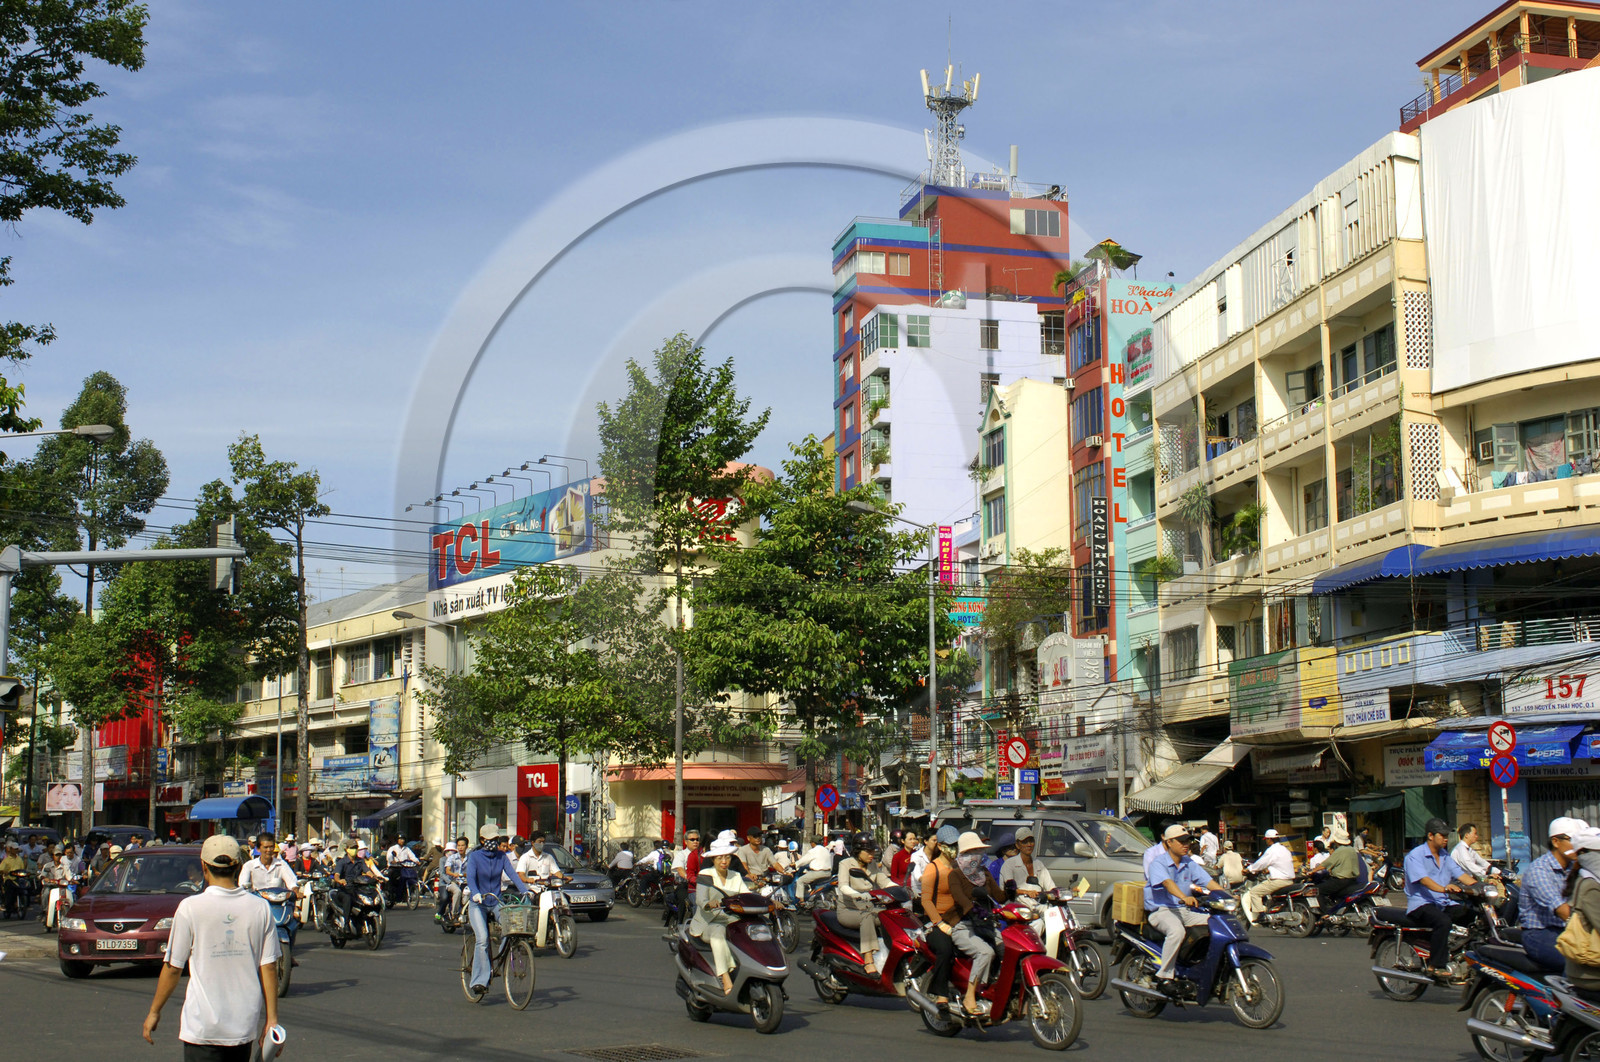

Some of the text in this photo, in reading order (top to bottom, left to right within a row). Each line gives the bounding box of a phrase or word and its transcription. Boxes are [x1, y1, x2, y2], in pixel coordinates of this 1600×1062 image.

[1127, 286, 1173, 298] Khách
[1110, 296, 1156, 315] HOÀ
[1110, 363, 1127, 523] HOTEL
[432, 519, 501, 581] TCL
[433, 600, 448, 618] Nhà
[486, 587, 499, 604] TV
[1543, 674, 1588, 700] 157
[1443, 755, 1469, 763] PEPSI
[1536, 750, 1564, 758] PEPSI
[526, 772, 549, 789] TCL
